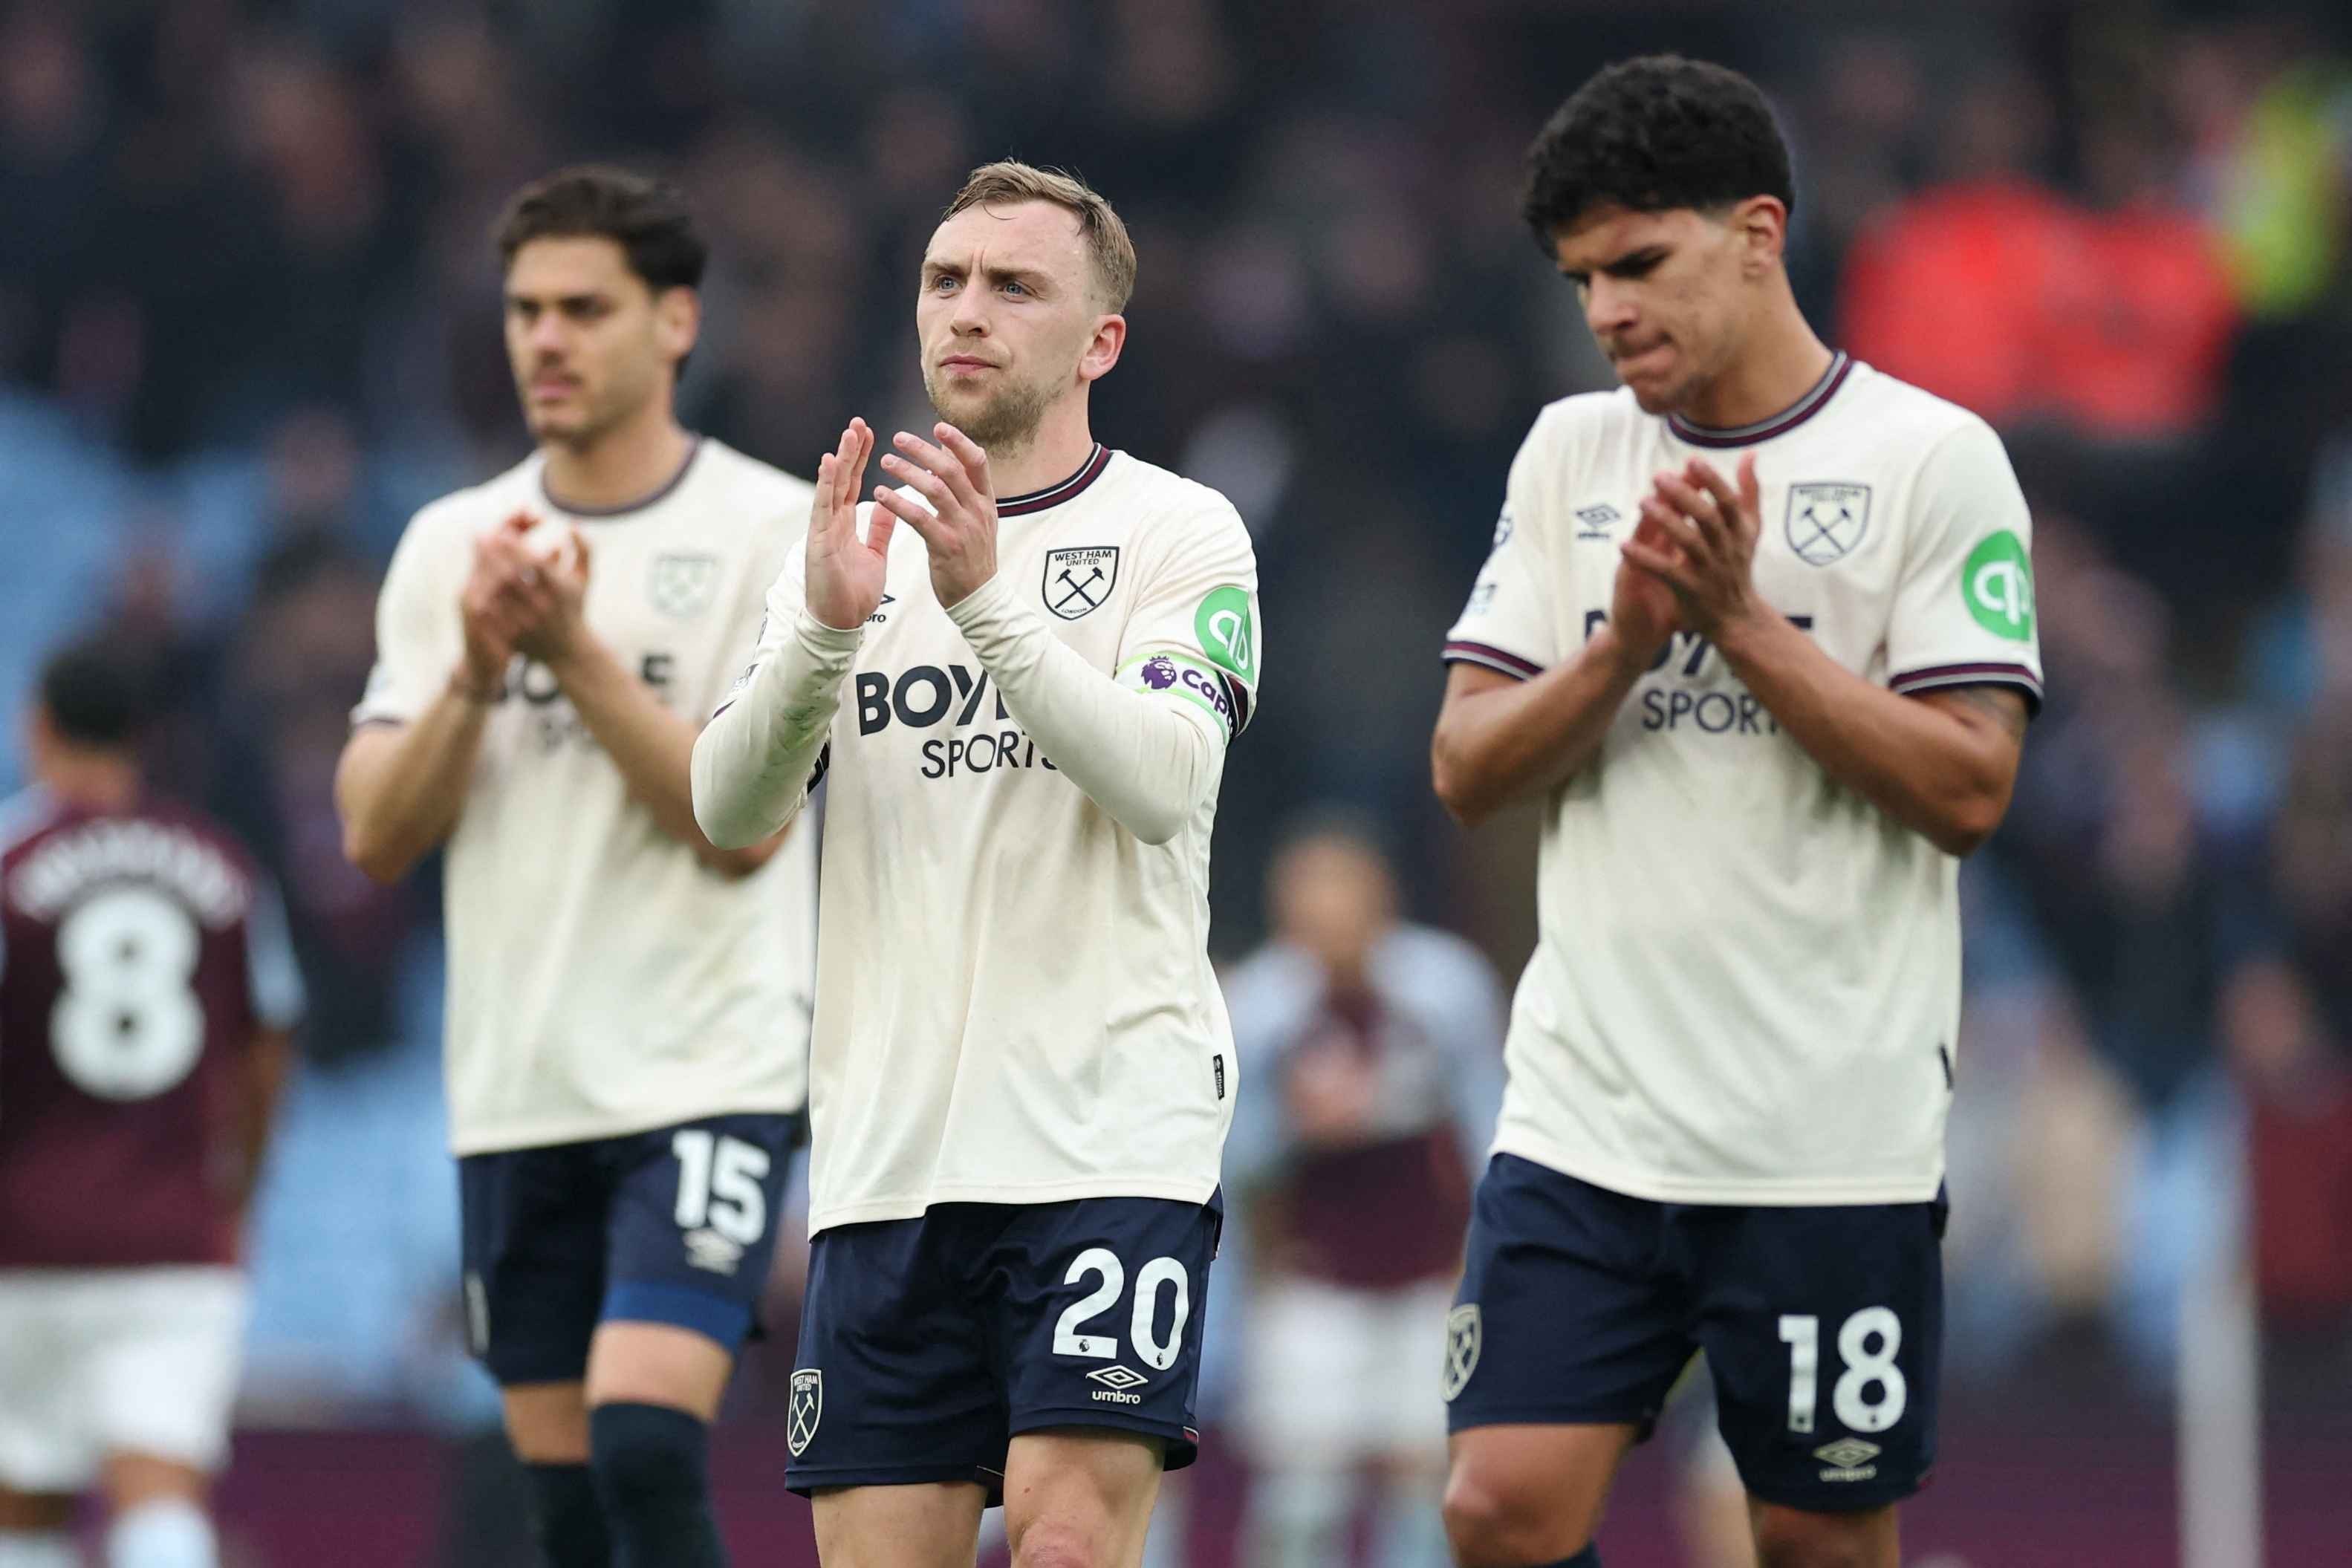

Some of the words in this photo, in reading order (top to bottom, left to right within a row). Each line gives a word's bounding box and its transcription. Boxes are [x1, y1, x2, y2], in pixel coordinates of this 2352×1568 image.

[1054, 551, 1084, 562] WEST
[1086, 550, 1112, 559] HAM
[1066, 558, 1099, 567] UNITED
[1182, 668, 1233, 728] Cap
[1641, 689, 1777, 734] SPOR
[921, 730, 1058, 778] SPORT
[48, 890, 207, 1102] 8
[672, 1129, 770, 1246] 15
[1053, 1248, 1189, 1370] 20
[805, 1374, 818, 1385] HAM
[1778, 1306, 1907, 1434] 18
[1091, 1390, 1141, 1404] umbro
